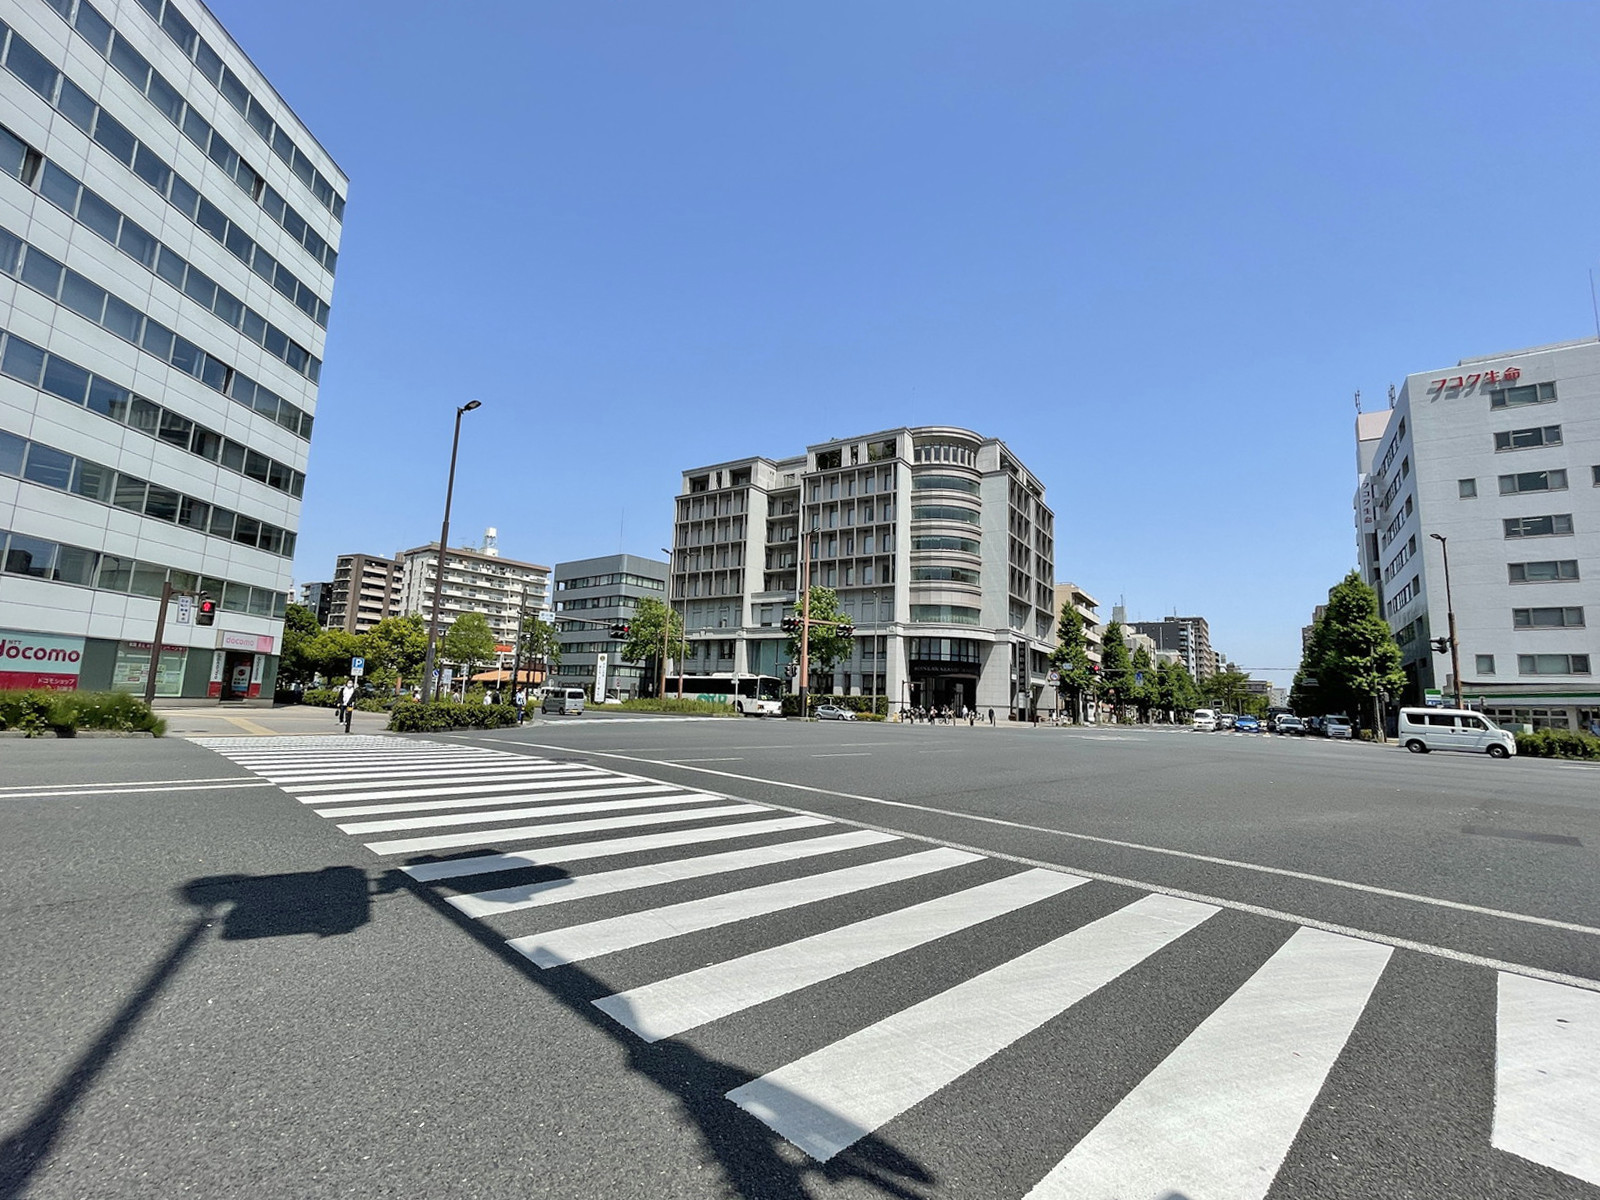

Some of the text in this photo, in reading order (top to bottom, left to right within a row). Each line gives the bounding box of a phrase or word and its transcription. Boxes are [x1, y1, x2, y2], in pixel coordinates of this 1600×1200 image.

[1431, 367, 1520, 393] フコク生命
[1362, 482, 1373, 523] フコク生命
[226, 636, 255, 647] docomo
